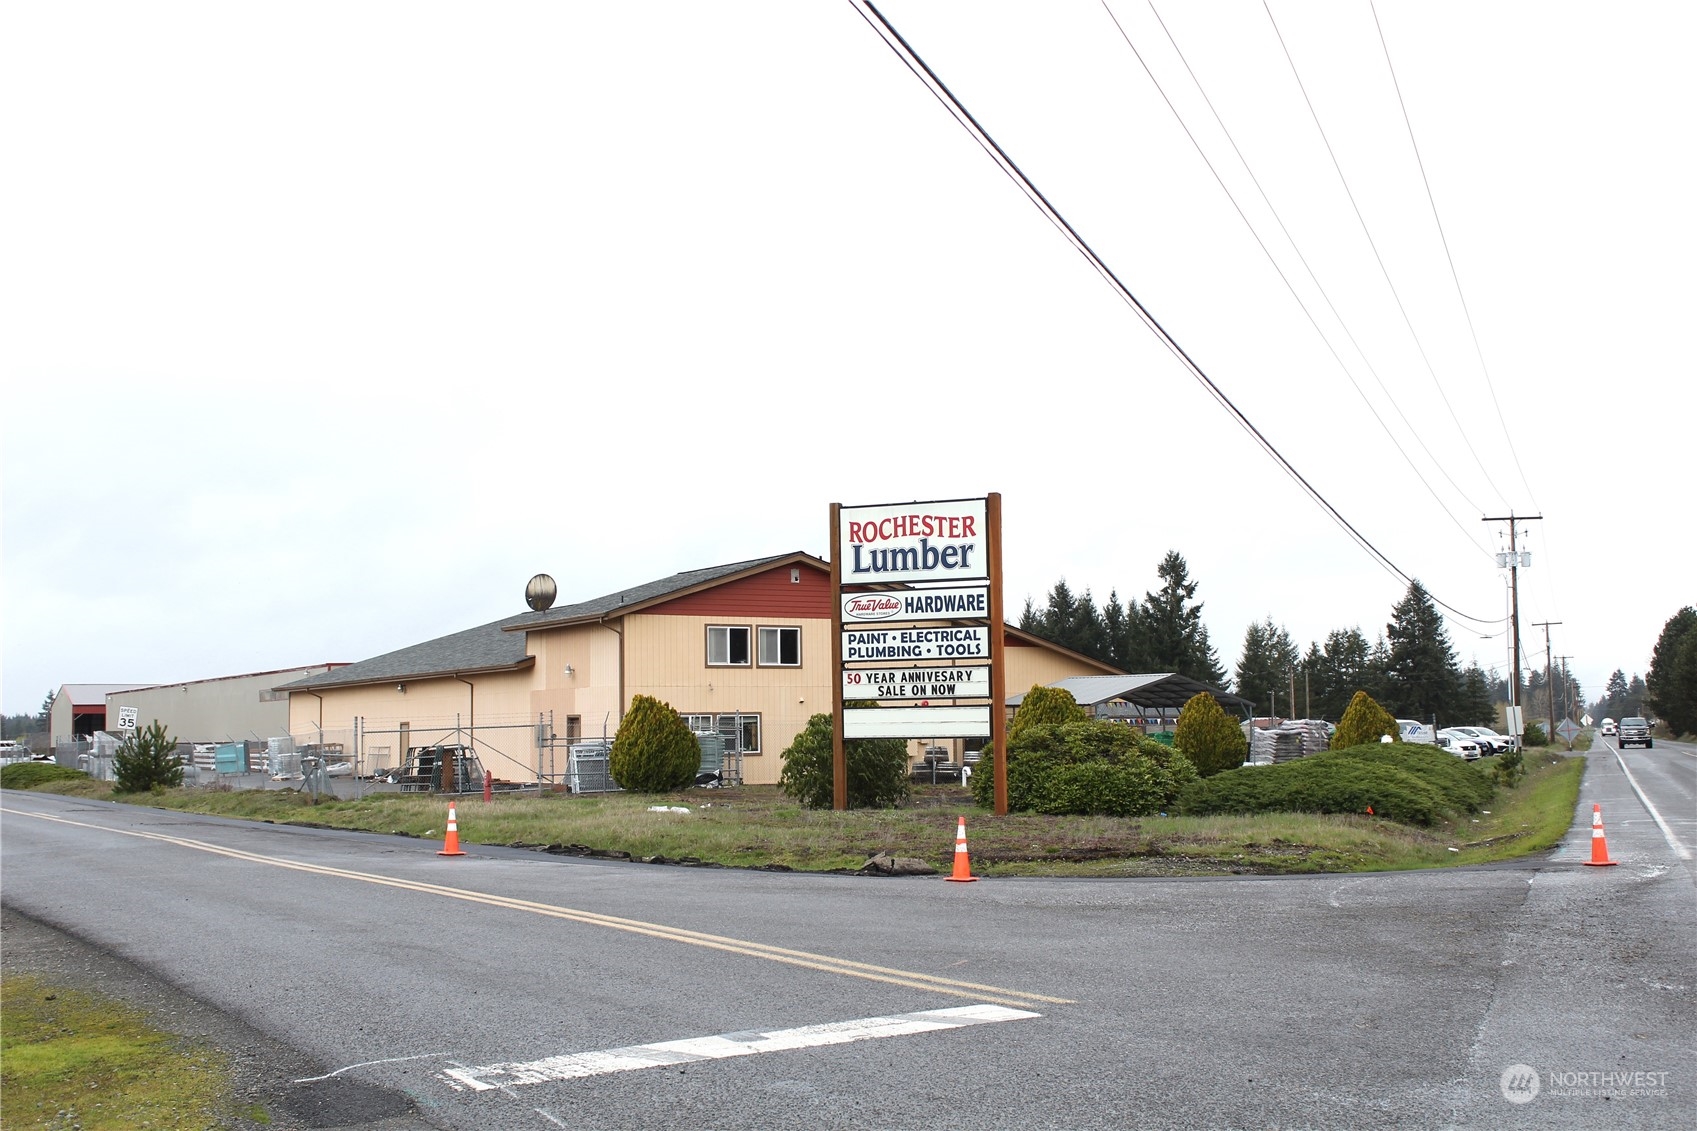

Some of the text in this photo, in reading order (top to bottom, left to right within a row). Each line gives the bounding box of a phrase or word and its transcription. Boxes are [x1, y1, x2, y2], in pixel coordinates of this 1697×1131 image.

[849, 515, 976, 543] ROCHESTER
[852, 537, 974, 573] Lumber
[904, 594, 985, 613] HARDWARE
[848, 629, 981, 645] PAINT ELECTRICAL
[848, 643, 981, 658] PLUMBING TOOLS
[847, 670, 972, 685] 50 YEAR ANNIVESARY
[878, 684, 956, 697] SALE ON NOW
[119, 718, 135, 727] 35
